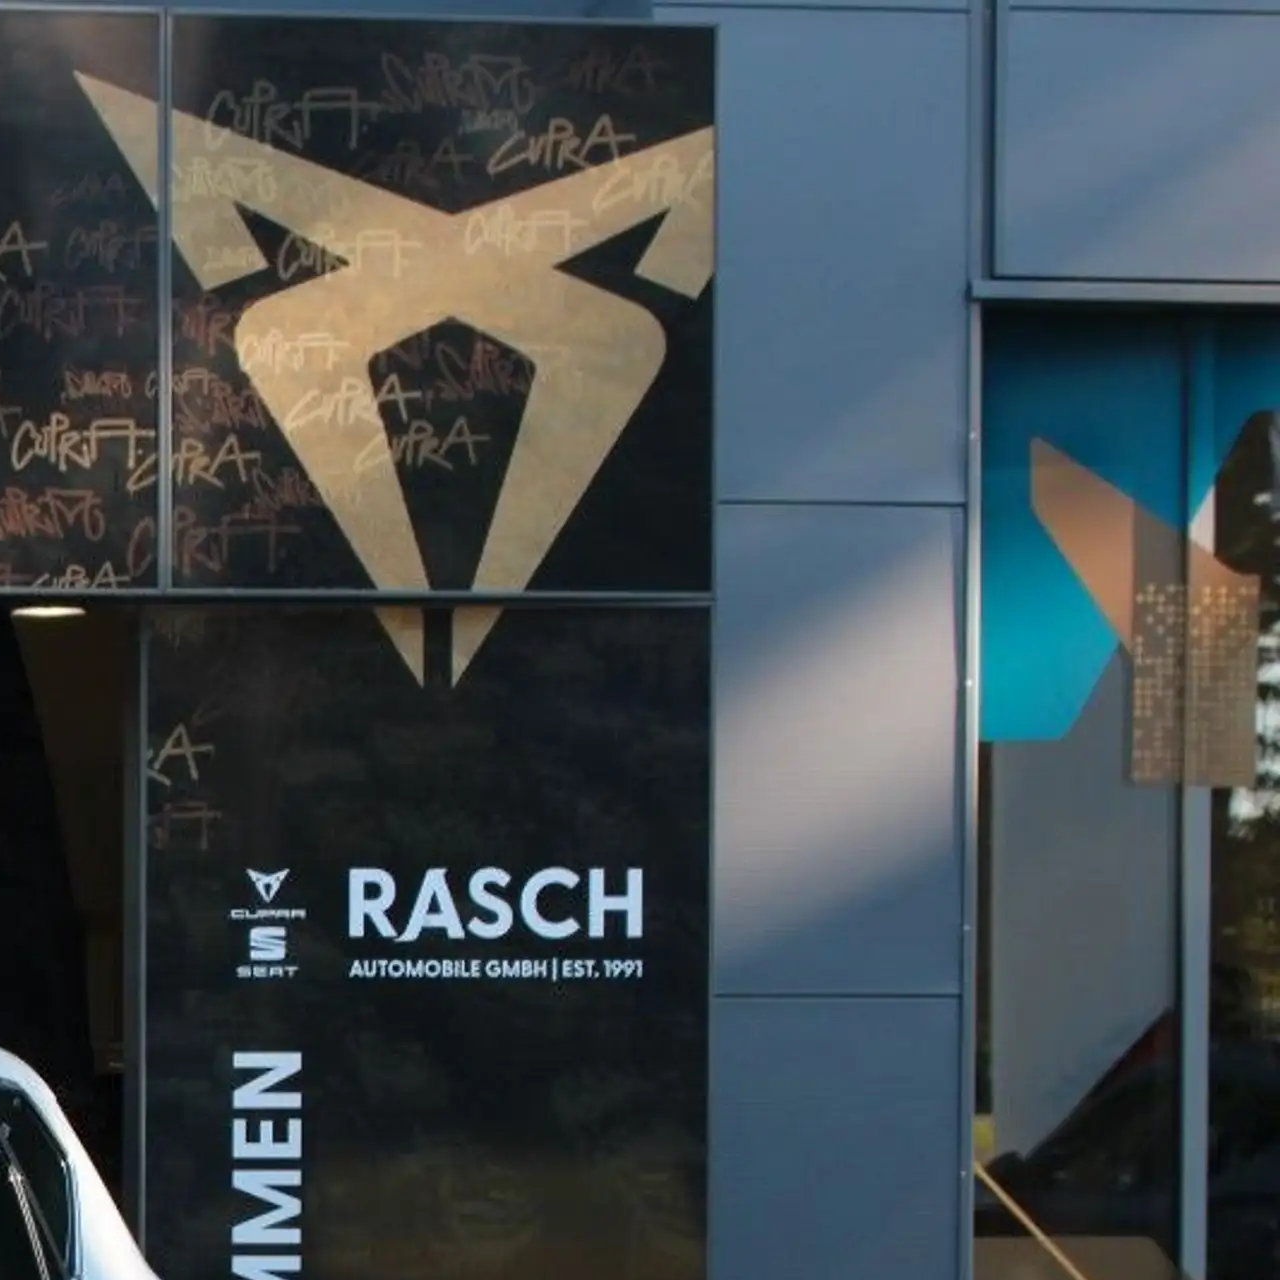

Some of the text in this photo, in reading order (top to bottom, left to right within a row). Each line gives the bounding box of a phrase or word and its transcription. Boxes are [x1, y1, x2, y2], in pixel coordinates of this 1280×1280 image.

[487, 113, 637, 177] CUPRA
[125, 432, 261, 493] CPRA
[353, 415, 490, 473] CUPRA
[230, 908, 306, 920] CUPRA
[348, 867, 643, 942] RASCH
[236, 965, 299, 978] SEAT
[348, 959, 643, 979] AUTOMOBILE GMBH EST. 1991
